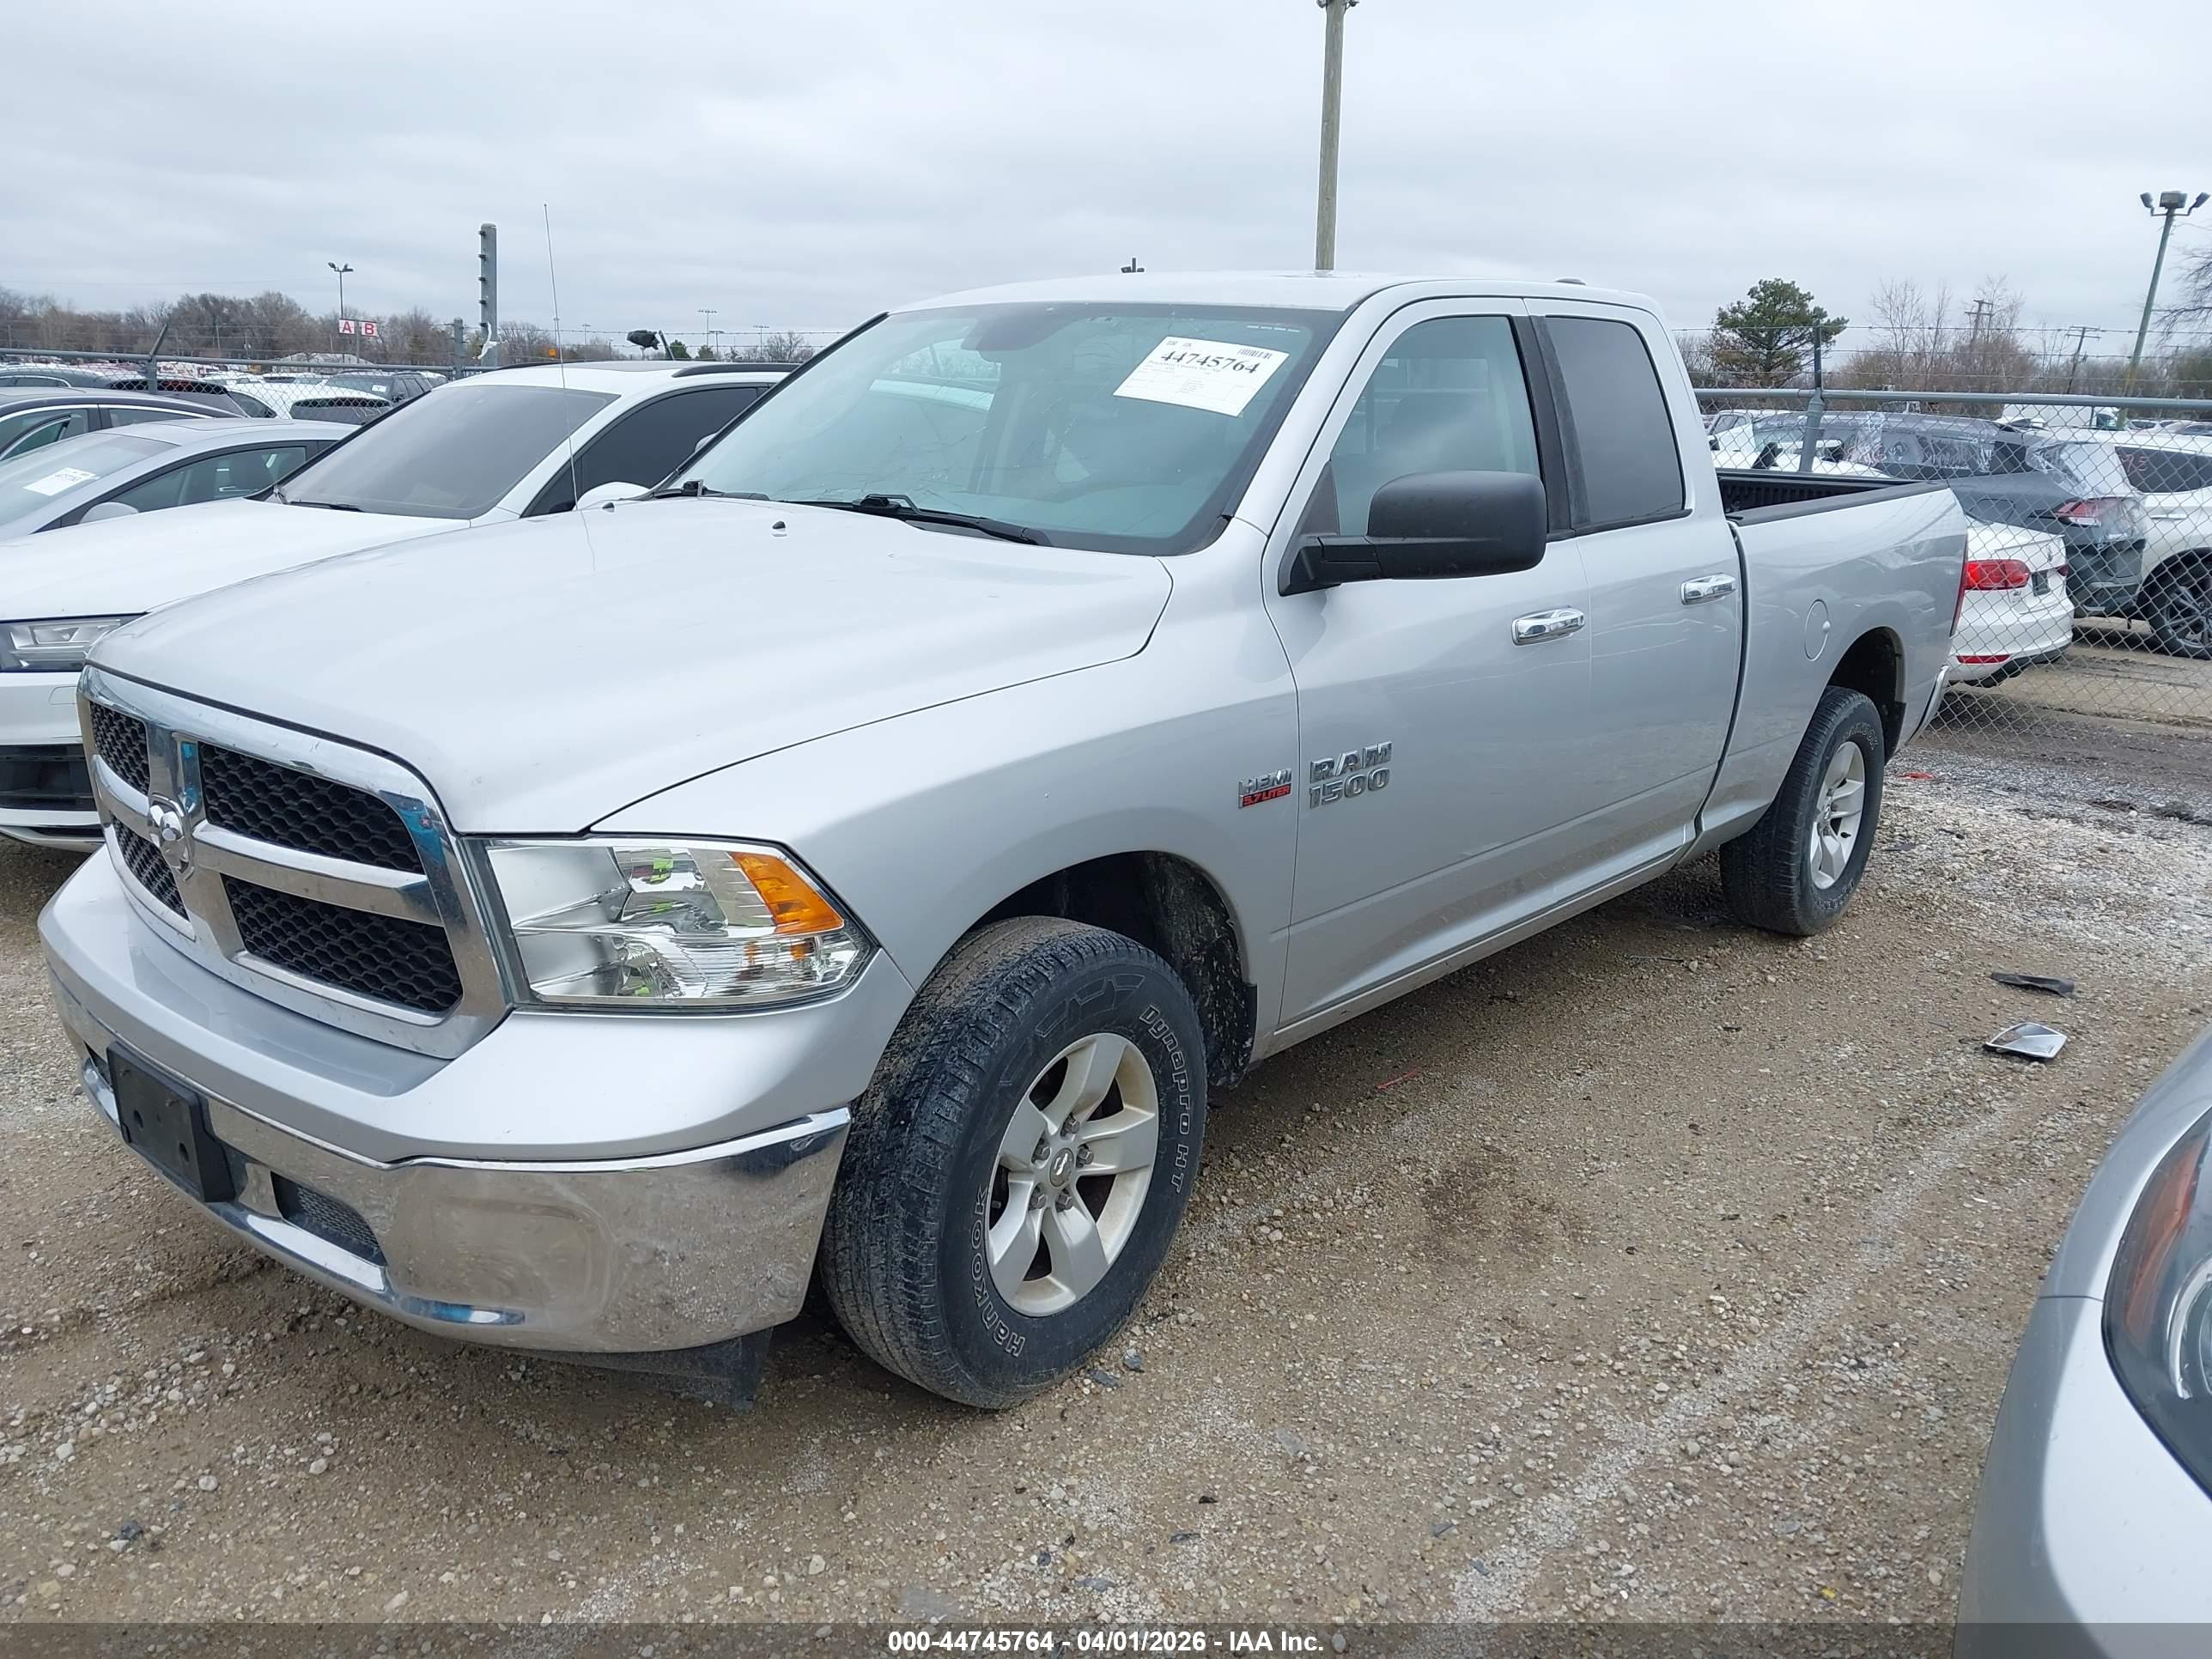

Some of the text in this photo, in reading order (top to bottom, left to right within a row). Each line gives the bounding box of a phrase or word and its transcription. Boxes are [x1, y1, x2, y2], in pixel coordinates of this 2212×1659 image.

[343, 321, 352, 333] A
[364, 323, 374, 335] B
[1161, 350, 1261, 374] 44745764
[1310, 741, 1393, 784] RAM
[1238, 769, 1292, 796] HEMI
[1310, 768, 1390, 809] 1500
[1139, 1005, 1191, 1194] Dynapro HT
